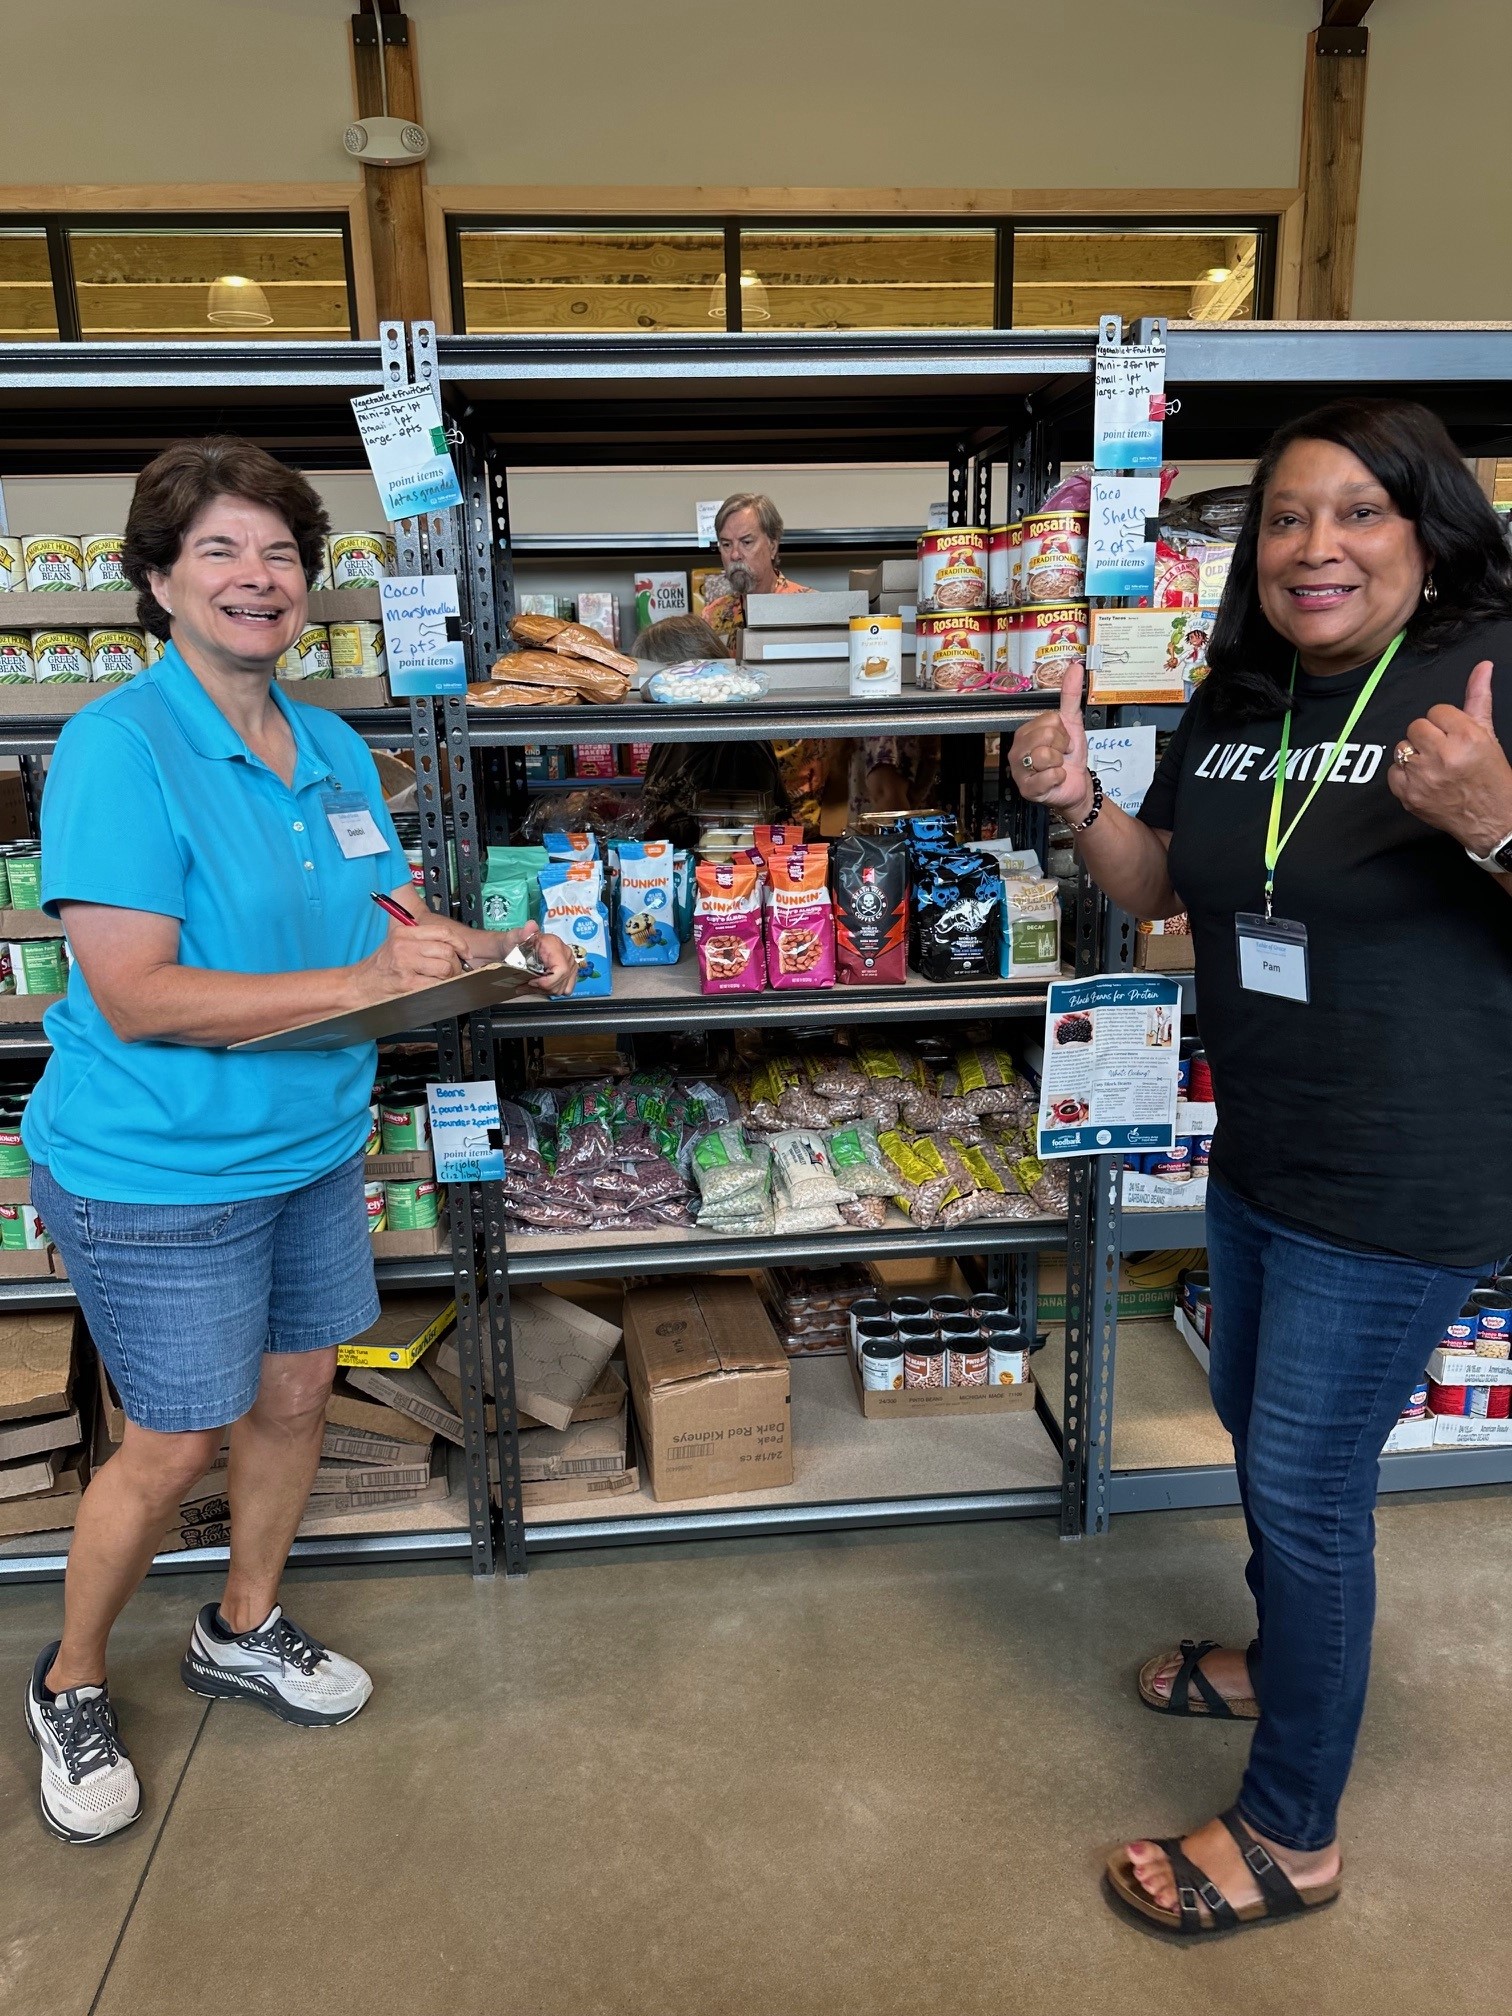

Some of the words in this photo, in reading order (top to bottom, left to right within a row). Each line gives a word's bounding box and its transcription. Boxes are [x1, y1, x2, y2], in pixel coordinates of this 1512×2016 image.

[1097, 388, 1118, 399] large
[364, 433, 392, 446] large
[1103, 429, 1125, 440] point
[1127, 429, 1152, 438] items
[388, 475, 415, 491] point
[416, 468, 444, 482] items
[1093, 484, 1120, 501] Taco
[388, 491, 419, 508] latas
[1103, 506, 1146, 525] Shells
[1029, 517, 1082, 538] Rosarita
[936, 533, 983, 552] Rosarita
[1094, 540, 1105, 552] 2
[345, 560, 373, 568] GREEN
[1032, 555, 1079, 565] TRADITIONAL
[1096, 558, 1118, 568] point
[1120, 558, 1145, 567] items
[39, 564, 70, 572] GREEN
[348, 568, 374, 576] BEANS
[1205, 565, 1224, 577] OLD
[42, 572, 71, 580] BEANS
[103, 572, 125, 580] BEAN
[657, 588, 684, 599] CORN
[658, 599, 685, 609] FLAKES
[933, 615, 980, 633] Rosarita
[1036, 609, 1088, 628] Rosarita
[391, 638, 403, 654] 2
[102, 655, 132, 663] GREEN
[315, 652, 330, 660] GREE
[51, 663, 79, 671] BEANS
[105, 663, 132, 671] BEANS
[399, 658, 425, 669] point
[427, 657, 454, 666] items
[1088, 737, 1132, 750] Coffee
[1194, 743, 1265, 782] LIVE
[1258, 742, 1384, 784] UNITED
[1020, 904, 1052, 912] ROAST
[1263, 960, 1280, 972] Pam
[1068, 995, 1088, 1007] Black
[1090, 991, 1112, 1004] Beans
[1114, 991, 1125, 1002] for
[1128, 988, 1159, 1001] Protein
[1108, 1069, 1126, 1077] What's
[436, 1088, 465, 1098] Beans
[438, 1104, 463, 1115] pound
[432, 1119, 438, 1127] 2
[443, 1150, 467, 1159] point
[469, 1148, 493, 1157] items
[728, 1427, 752, 1438] Red
[757, 1422, 784, 1433] Dark
[673, 1431, 724, 1443] Kidneys
[757, 1435, 783, 1445] Peak
[755, 1450, 783, 1462] 24/1#
[201, 1530, 230, 1546] BOYA
